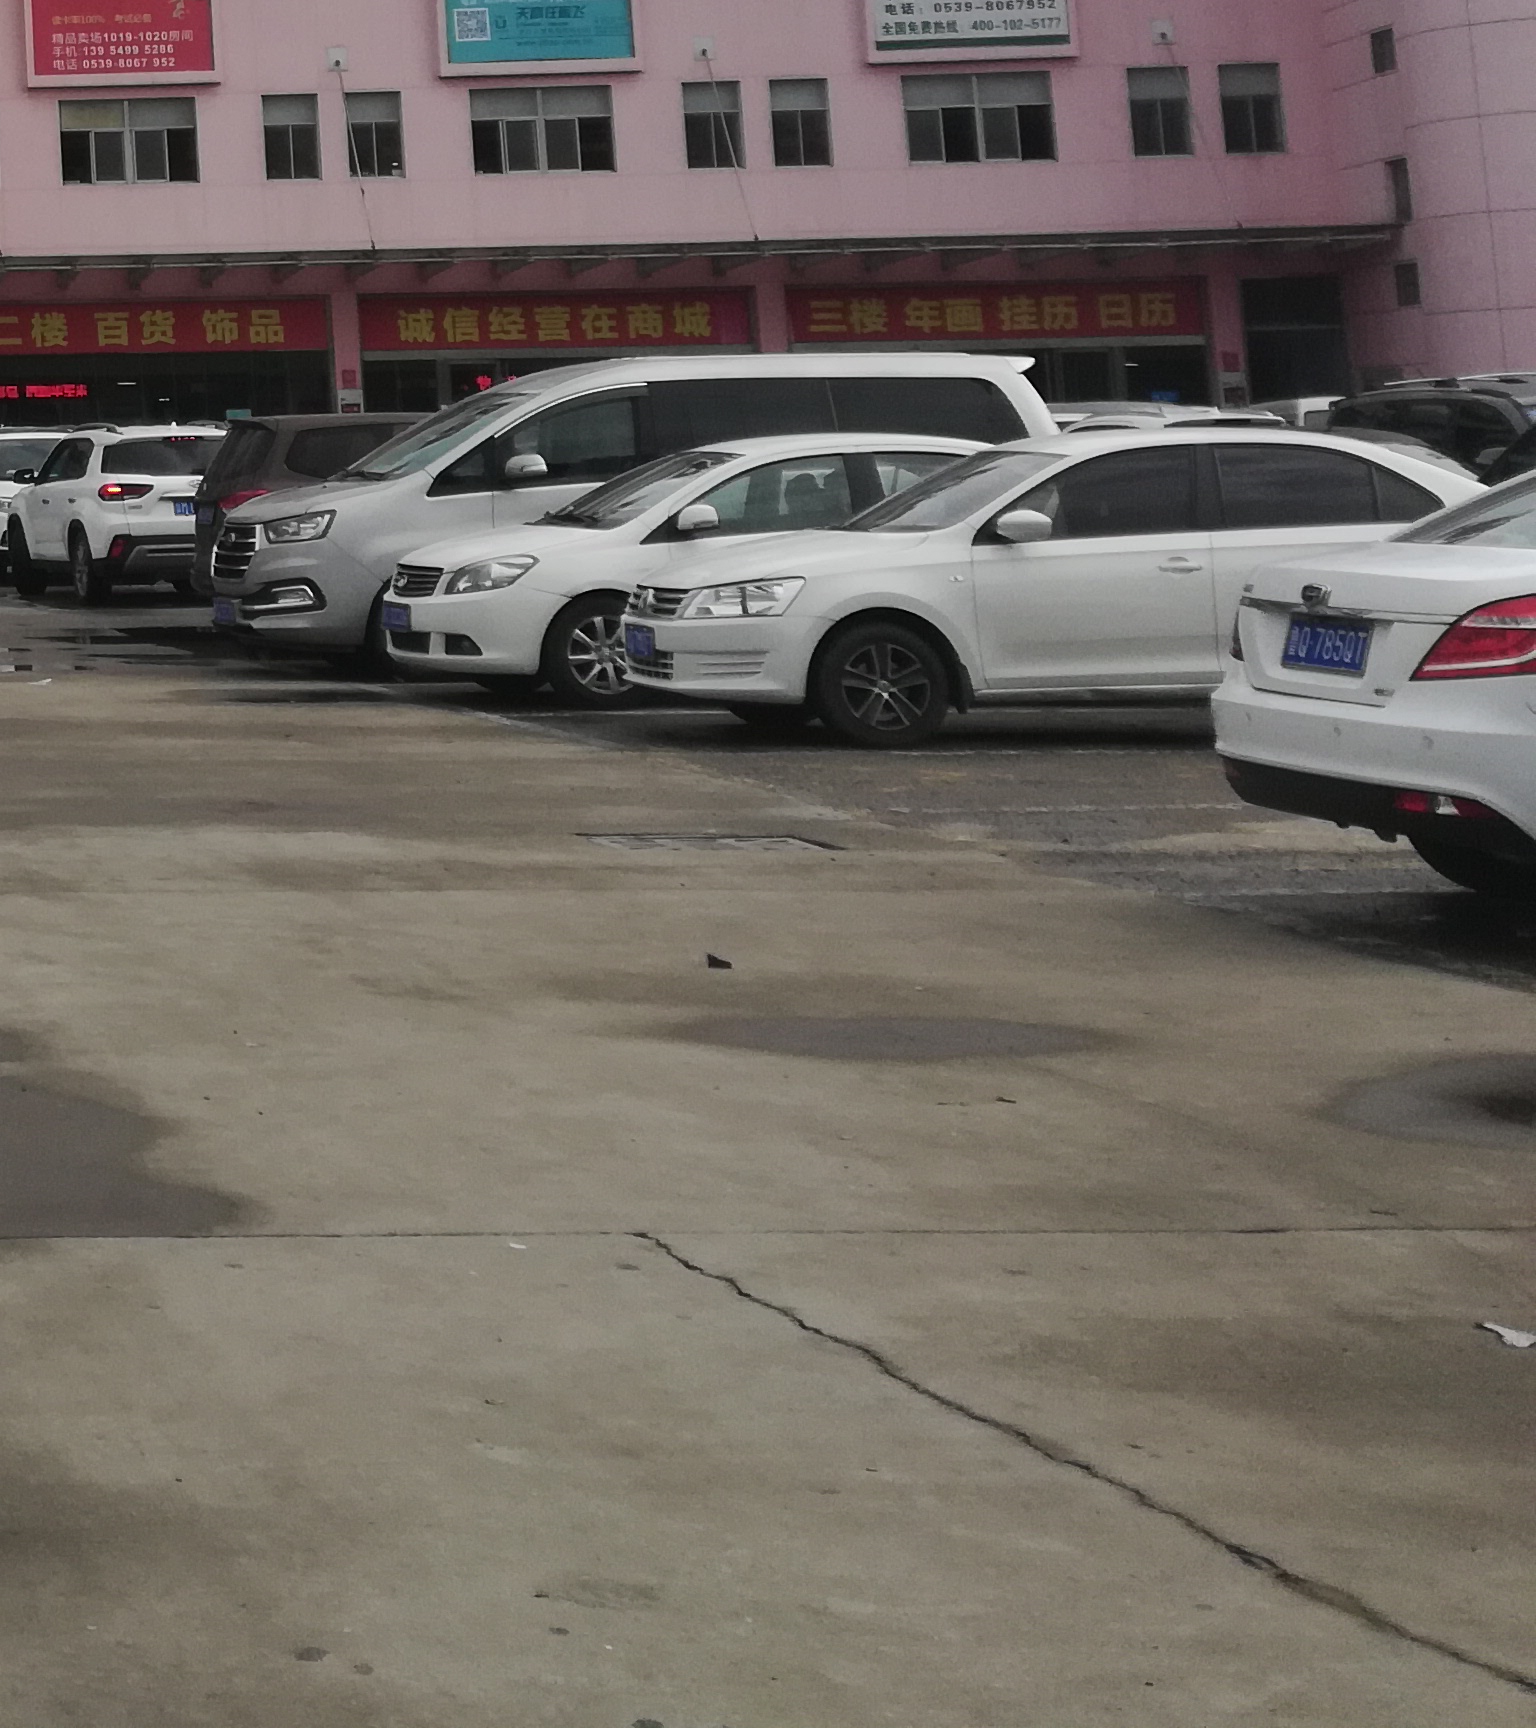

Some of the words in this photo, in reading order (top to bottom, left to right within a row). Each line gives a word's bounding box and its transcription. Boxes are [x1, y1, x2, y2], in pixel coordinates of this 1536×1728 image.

[53, 46, 77, 57] 手机
[53, 59, 78, 70] 电话
[95, 310, 176, 346] 百货
[202, 308, 285, 345] 饰品
[398, 301, 711, 343] 诚信经营在商城
[809, 297, 888, 335] 三楼
[904, 296, 983, 333] 年画
[999, 294, 1080, 331] 挂历
[1099, 292, 1176, 329] 日历
